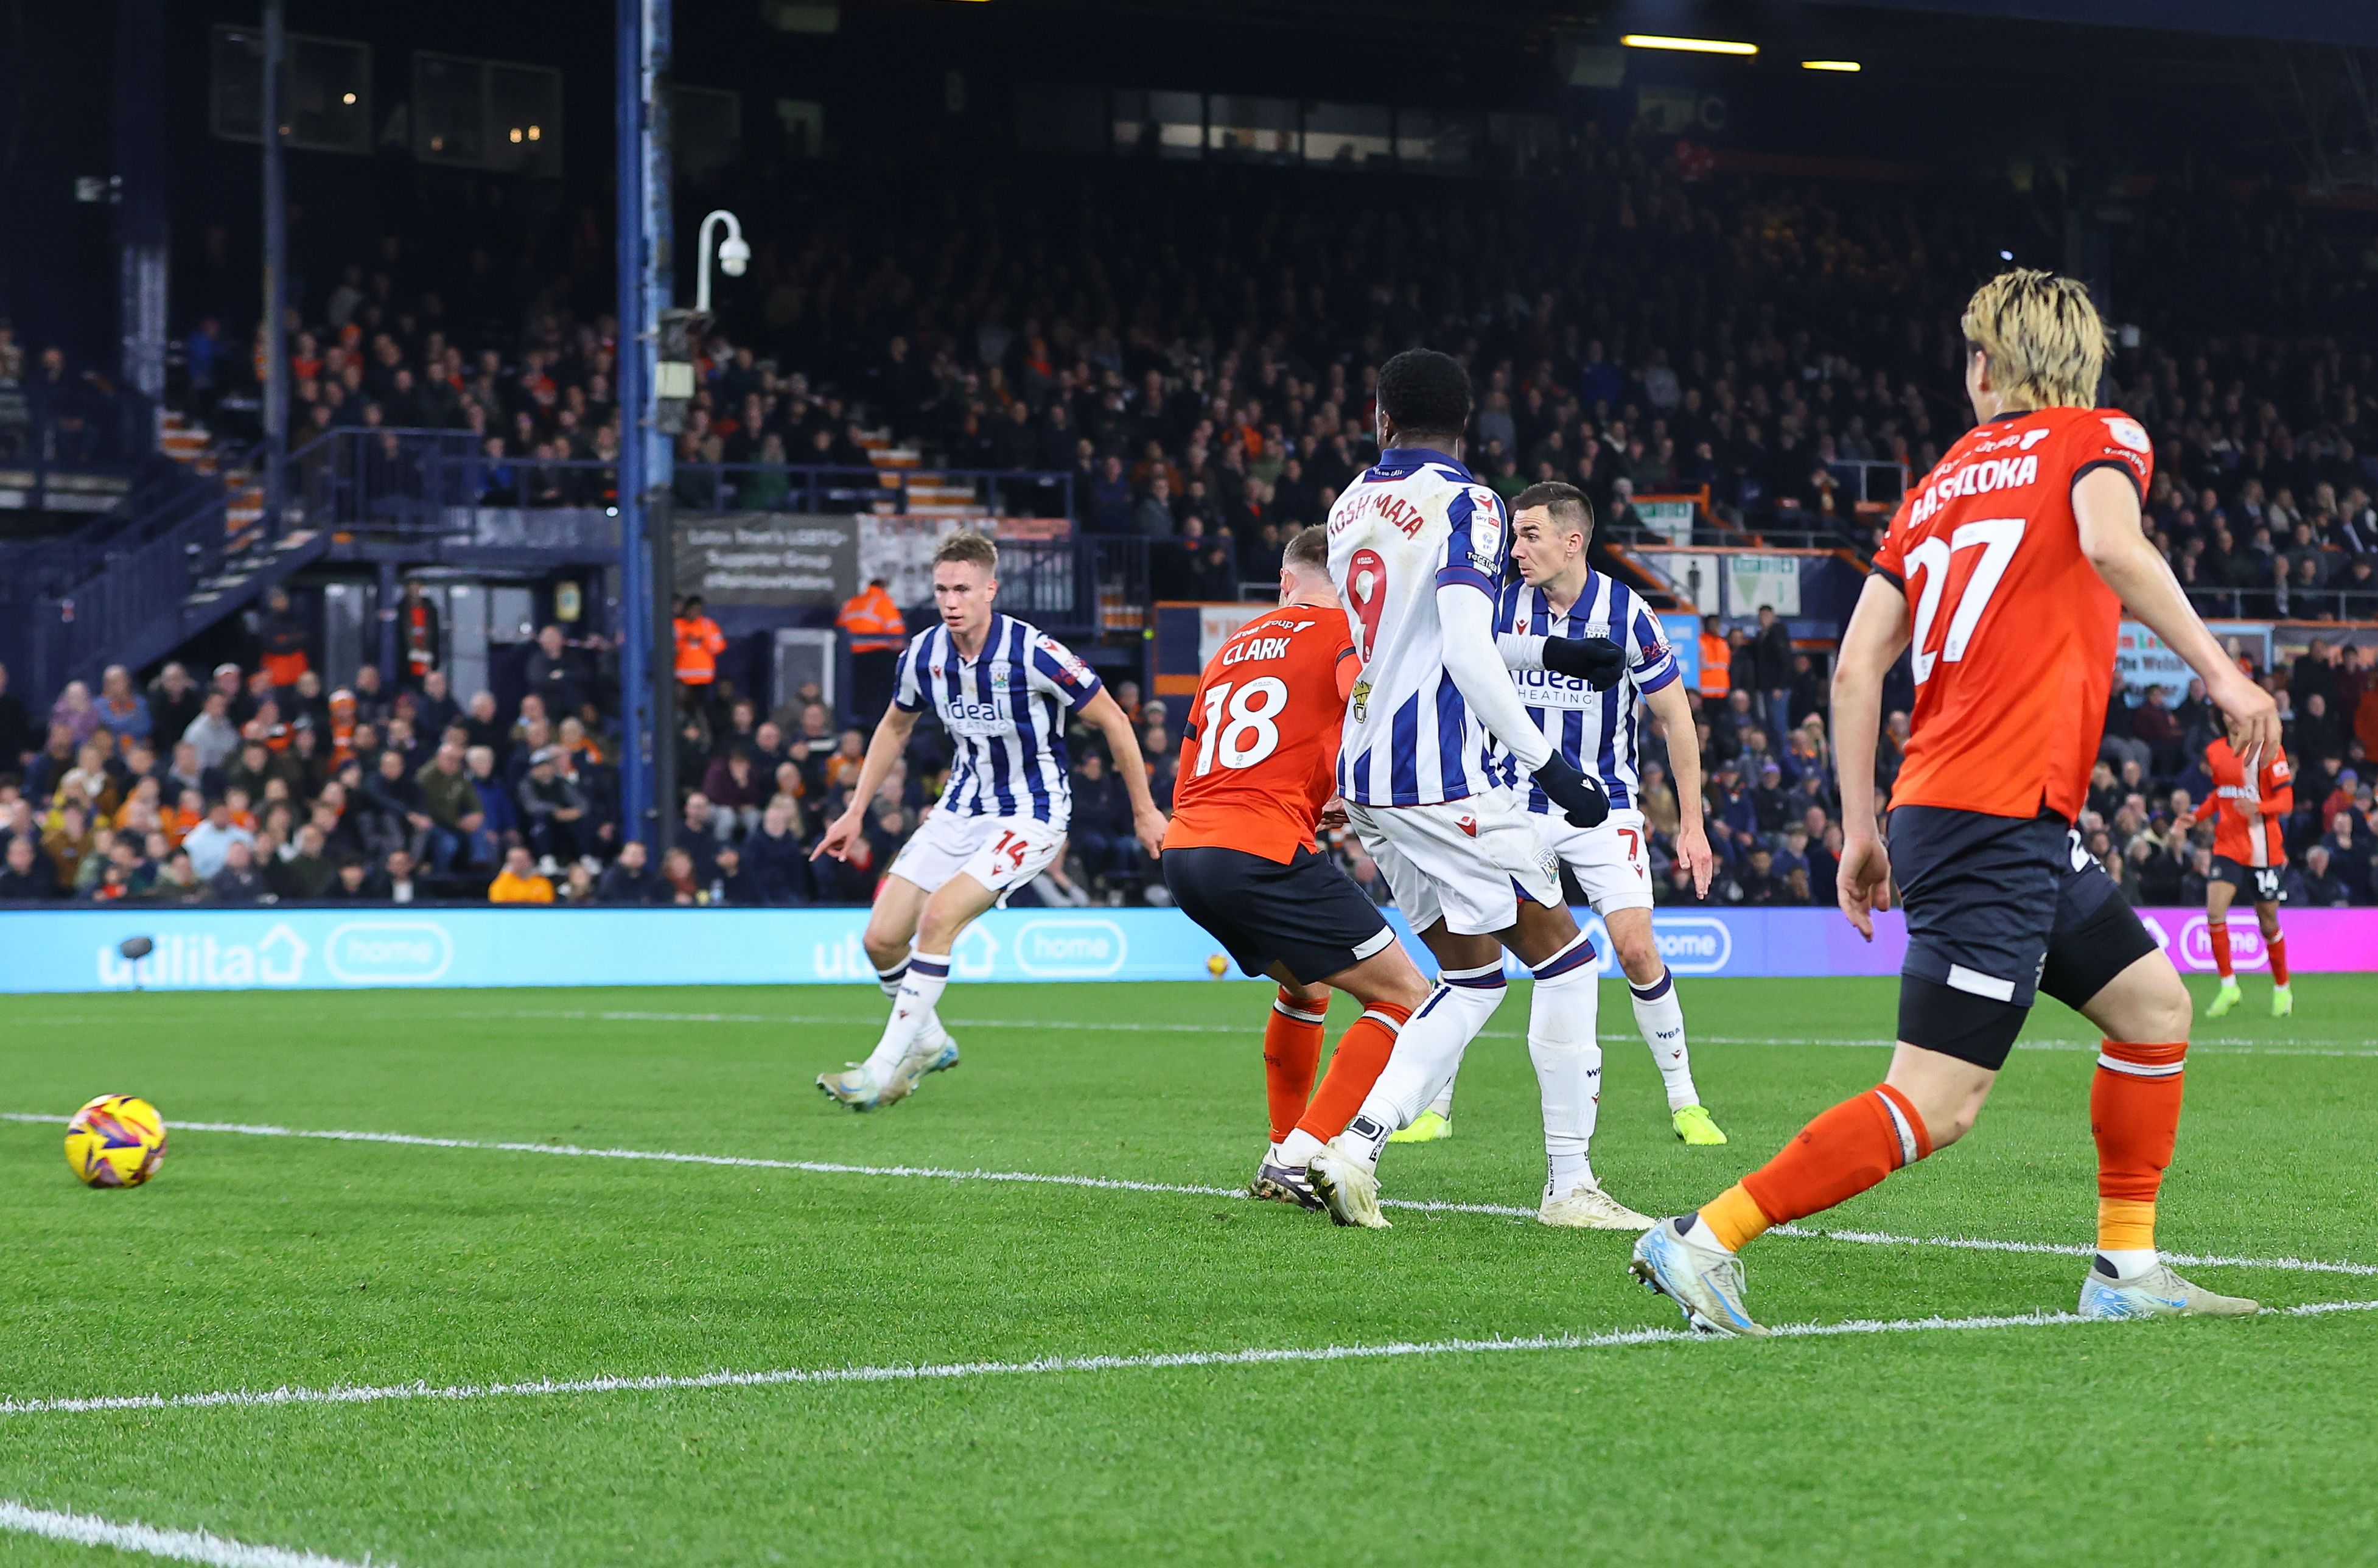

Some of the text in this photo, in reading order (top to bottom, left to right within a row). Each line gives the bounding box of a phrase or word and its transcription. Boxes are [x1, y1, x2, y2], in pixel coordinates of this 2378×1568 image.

[1328, 493, 1424, 544] JOSH MAJA
[1346, 548, 1387, 664] 9
[1903, 517, 2026, 687] 27
[1223, 637, 1292, 666] CLARK
[943, 695, 1004, 721] ideal
[1517, 689, 1593, 705] HEATING
[1195, 676, 1289, 778] 18
[991, 828, 1029, 871] 14
[1617, 828, 1638, 861] 7
[2254, 869, 2279, 894] 14
[347, 934, 433, 964] home
[1035, 931, 1111, 959] home
[1656, 1027, 1680, 1039] WBA
